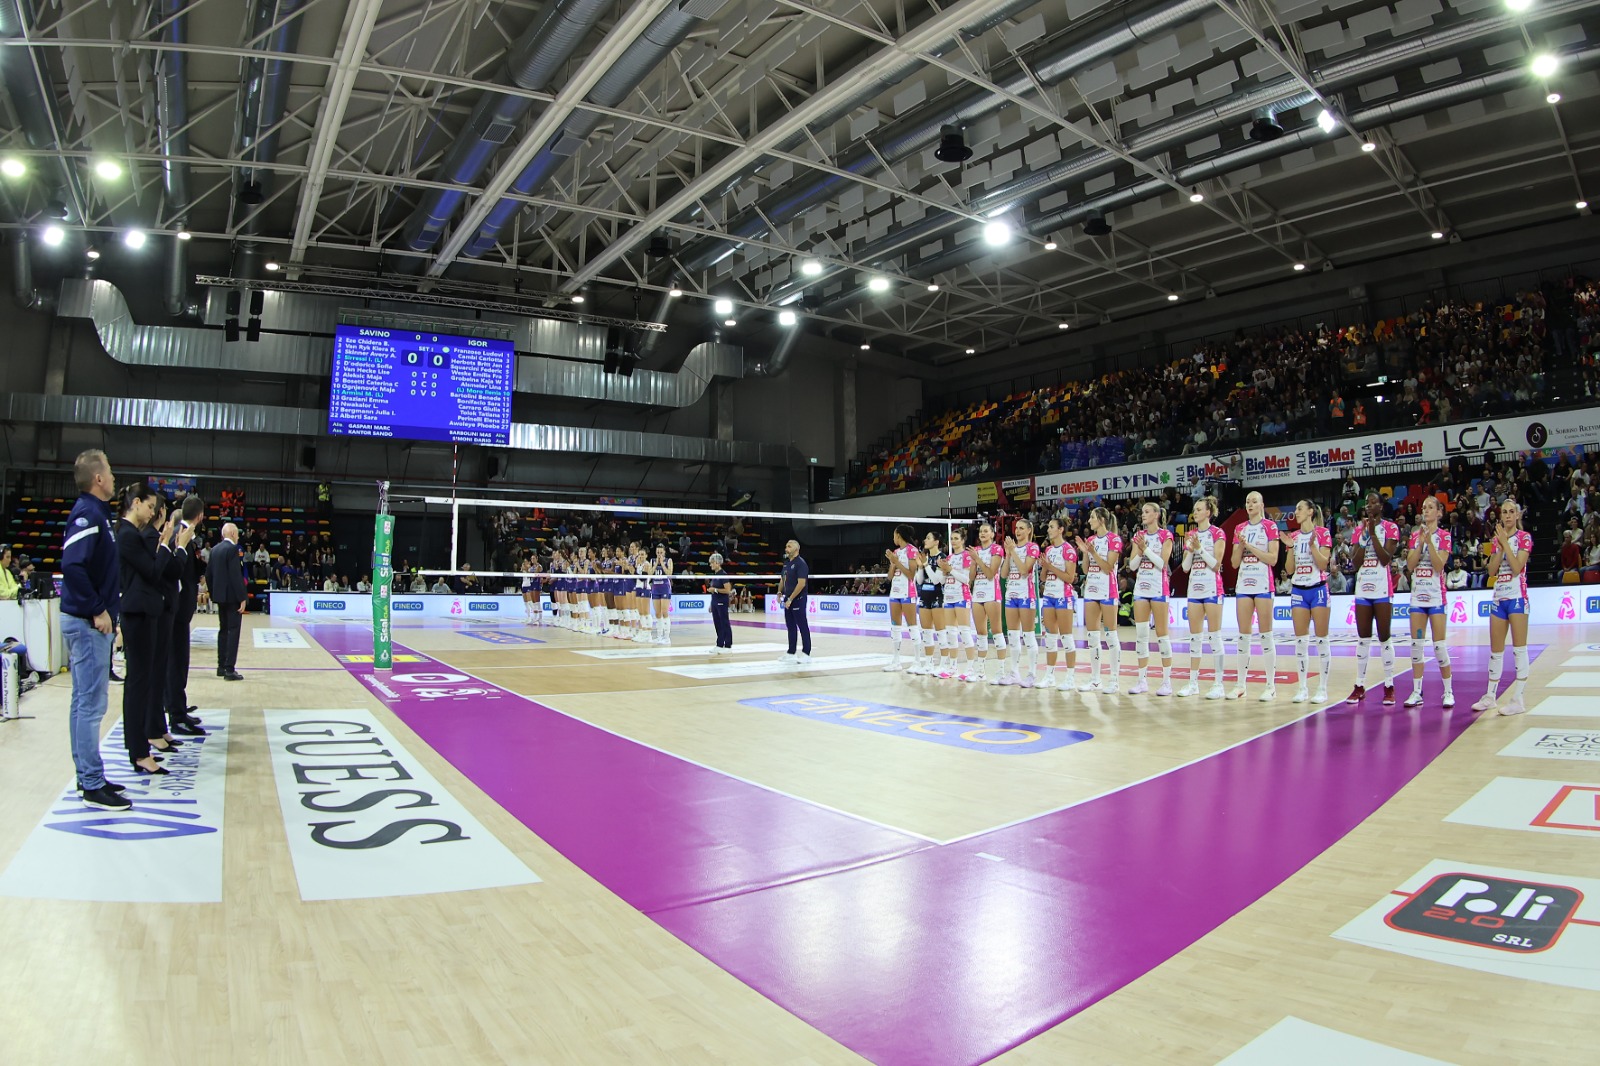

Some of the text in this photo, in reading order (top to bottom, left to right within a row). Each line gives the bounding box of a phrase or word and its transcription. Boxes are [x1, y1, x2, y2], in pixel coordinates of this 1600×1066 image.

[360, 329, 390, 337] SAVINO
[408, 353, 443, 366] 0 0
[1443, 425, 1505, 452] LCA
[1374, 439, 1423, 460] BigMat
[1246, 455, 1290, 473] BigMat
[1296, 448, 1355, 476] PALA BigMat
[1102, 472, 1159, 490] BEYFIN
[1176, 466, 1184, 487] PALA
[1248, 533, 1256, 543] 17
[1300, 543, 1307, 553] 11
[1317, 590, 1324, 598] 11
[769, 697, 1042, 744] FINECO
[280, 719, 472, 850] GUESS
[1434, 879, 1555, 921] Poli
[1422, 906, 1505, 929] 2.0
[1492, 934, 1533, 948] SRL
